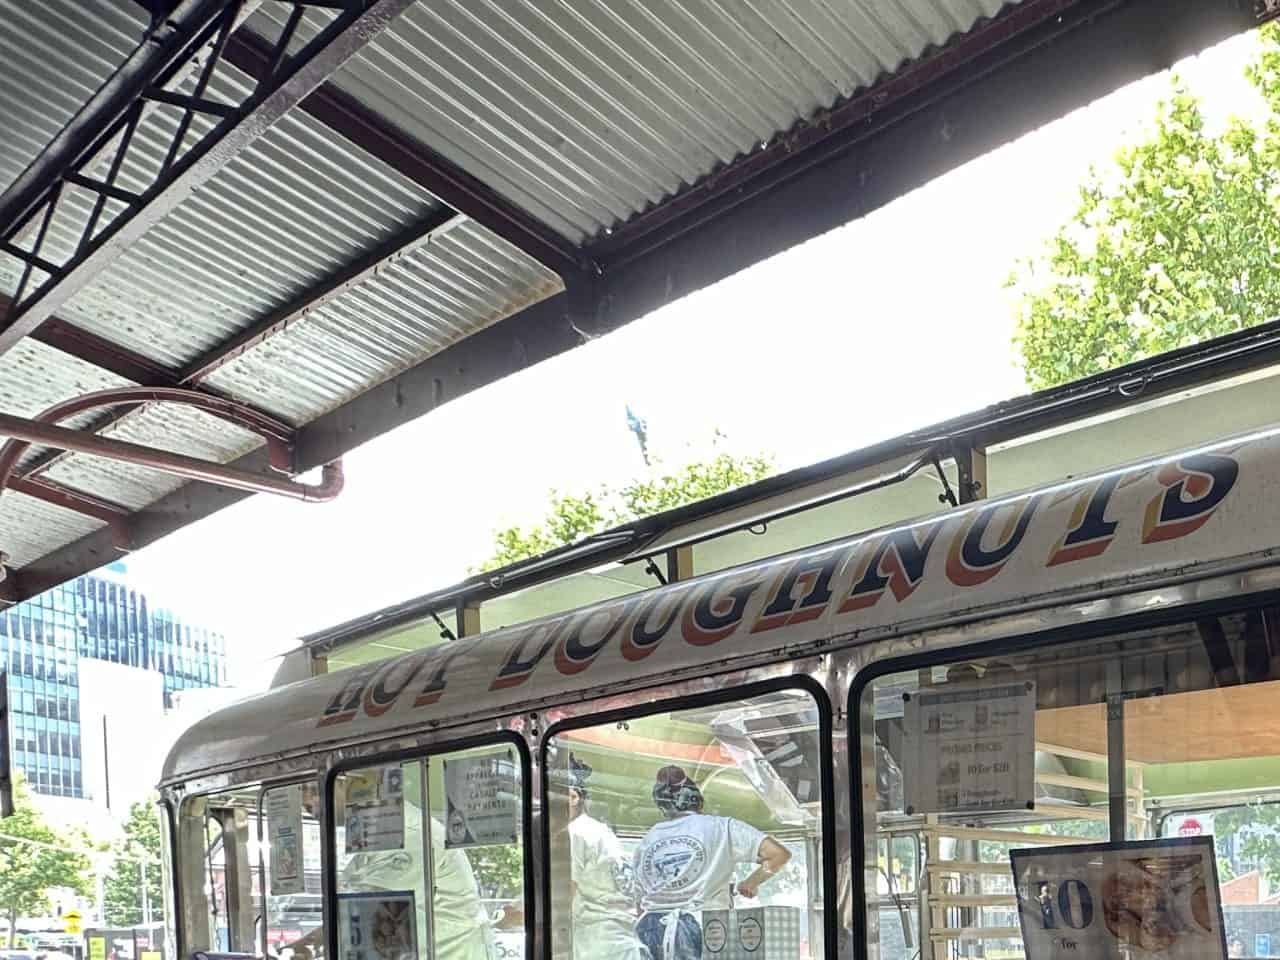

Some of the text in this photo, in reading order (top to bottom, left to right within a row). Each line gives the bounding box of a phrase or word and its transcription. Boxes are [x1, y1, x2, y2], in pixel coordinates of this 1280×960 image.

[318, 450, 1240, 727] HOT DOUGHNUTS
[1033, 880, 1093, 929] 10
[1060, 937, 1078, 950] for
